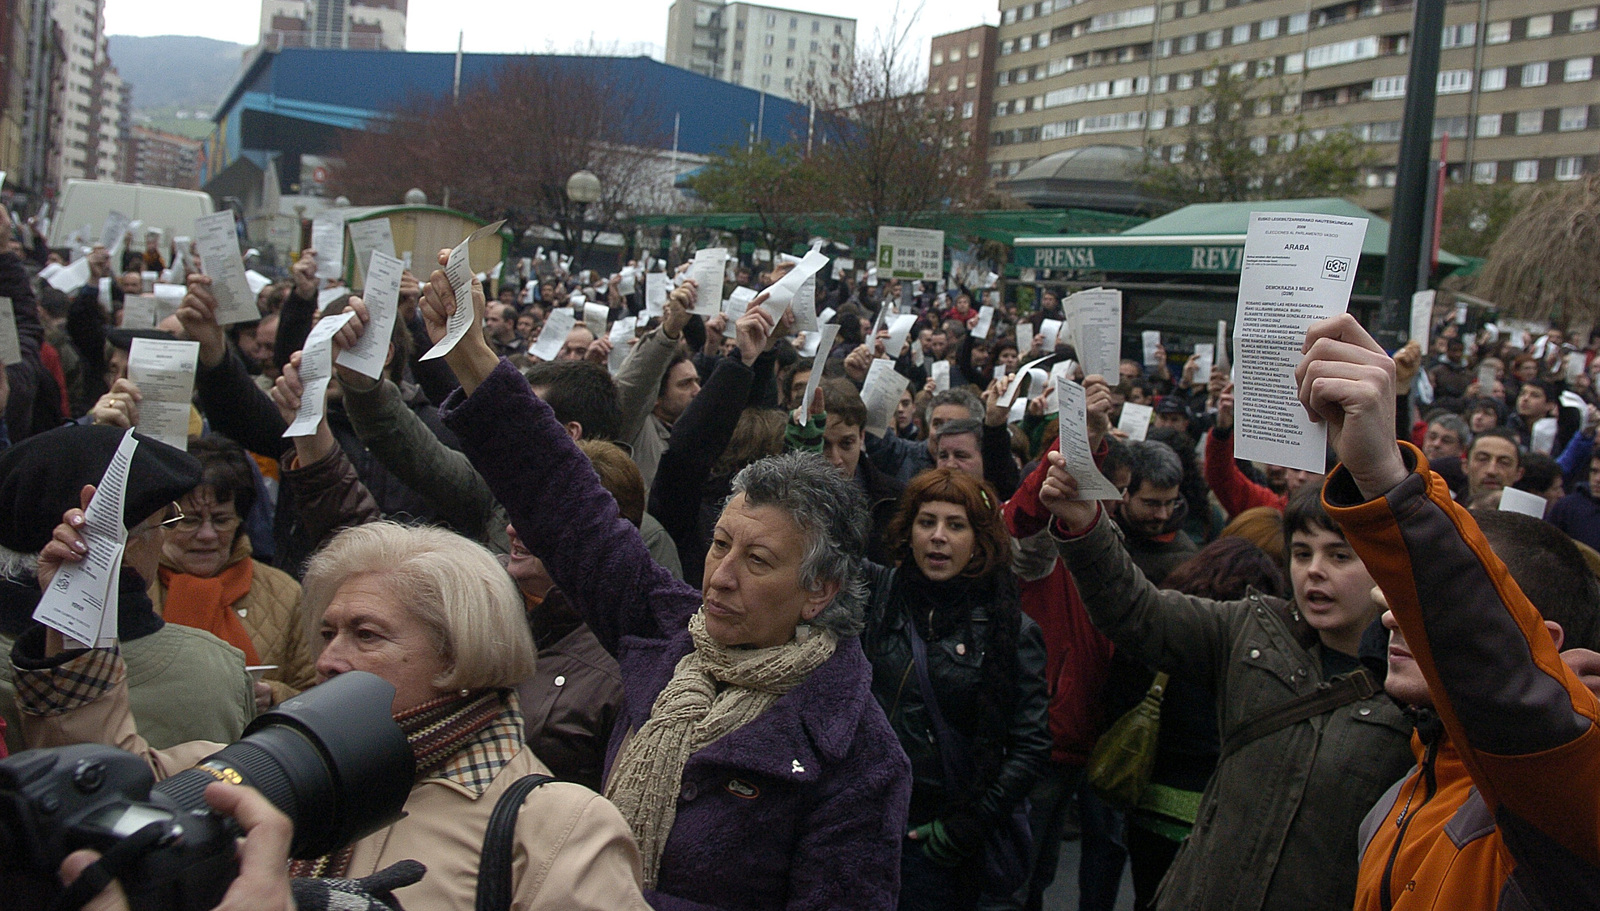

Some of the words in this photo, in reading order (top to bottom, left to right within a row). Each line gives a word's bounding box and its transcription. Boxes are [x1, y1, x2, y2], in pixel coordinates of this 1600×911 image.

[882, 250, 889, 263] 4
[1034, 248, 1096, 268] PRENSA
[1325, 259, 1347, 272] D3M
